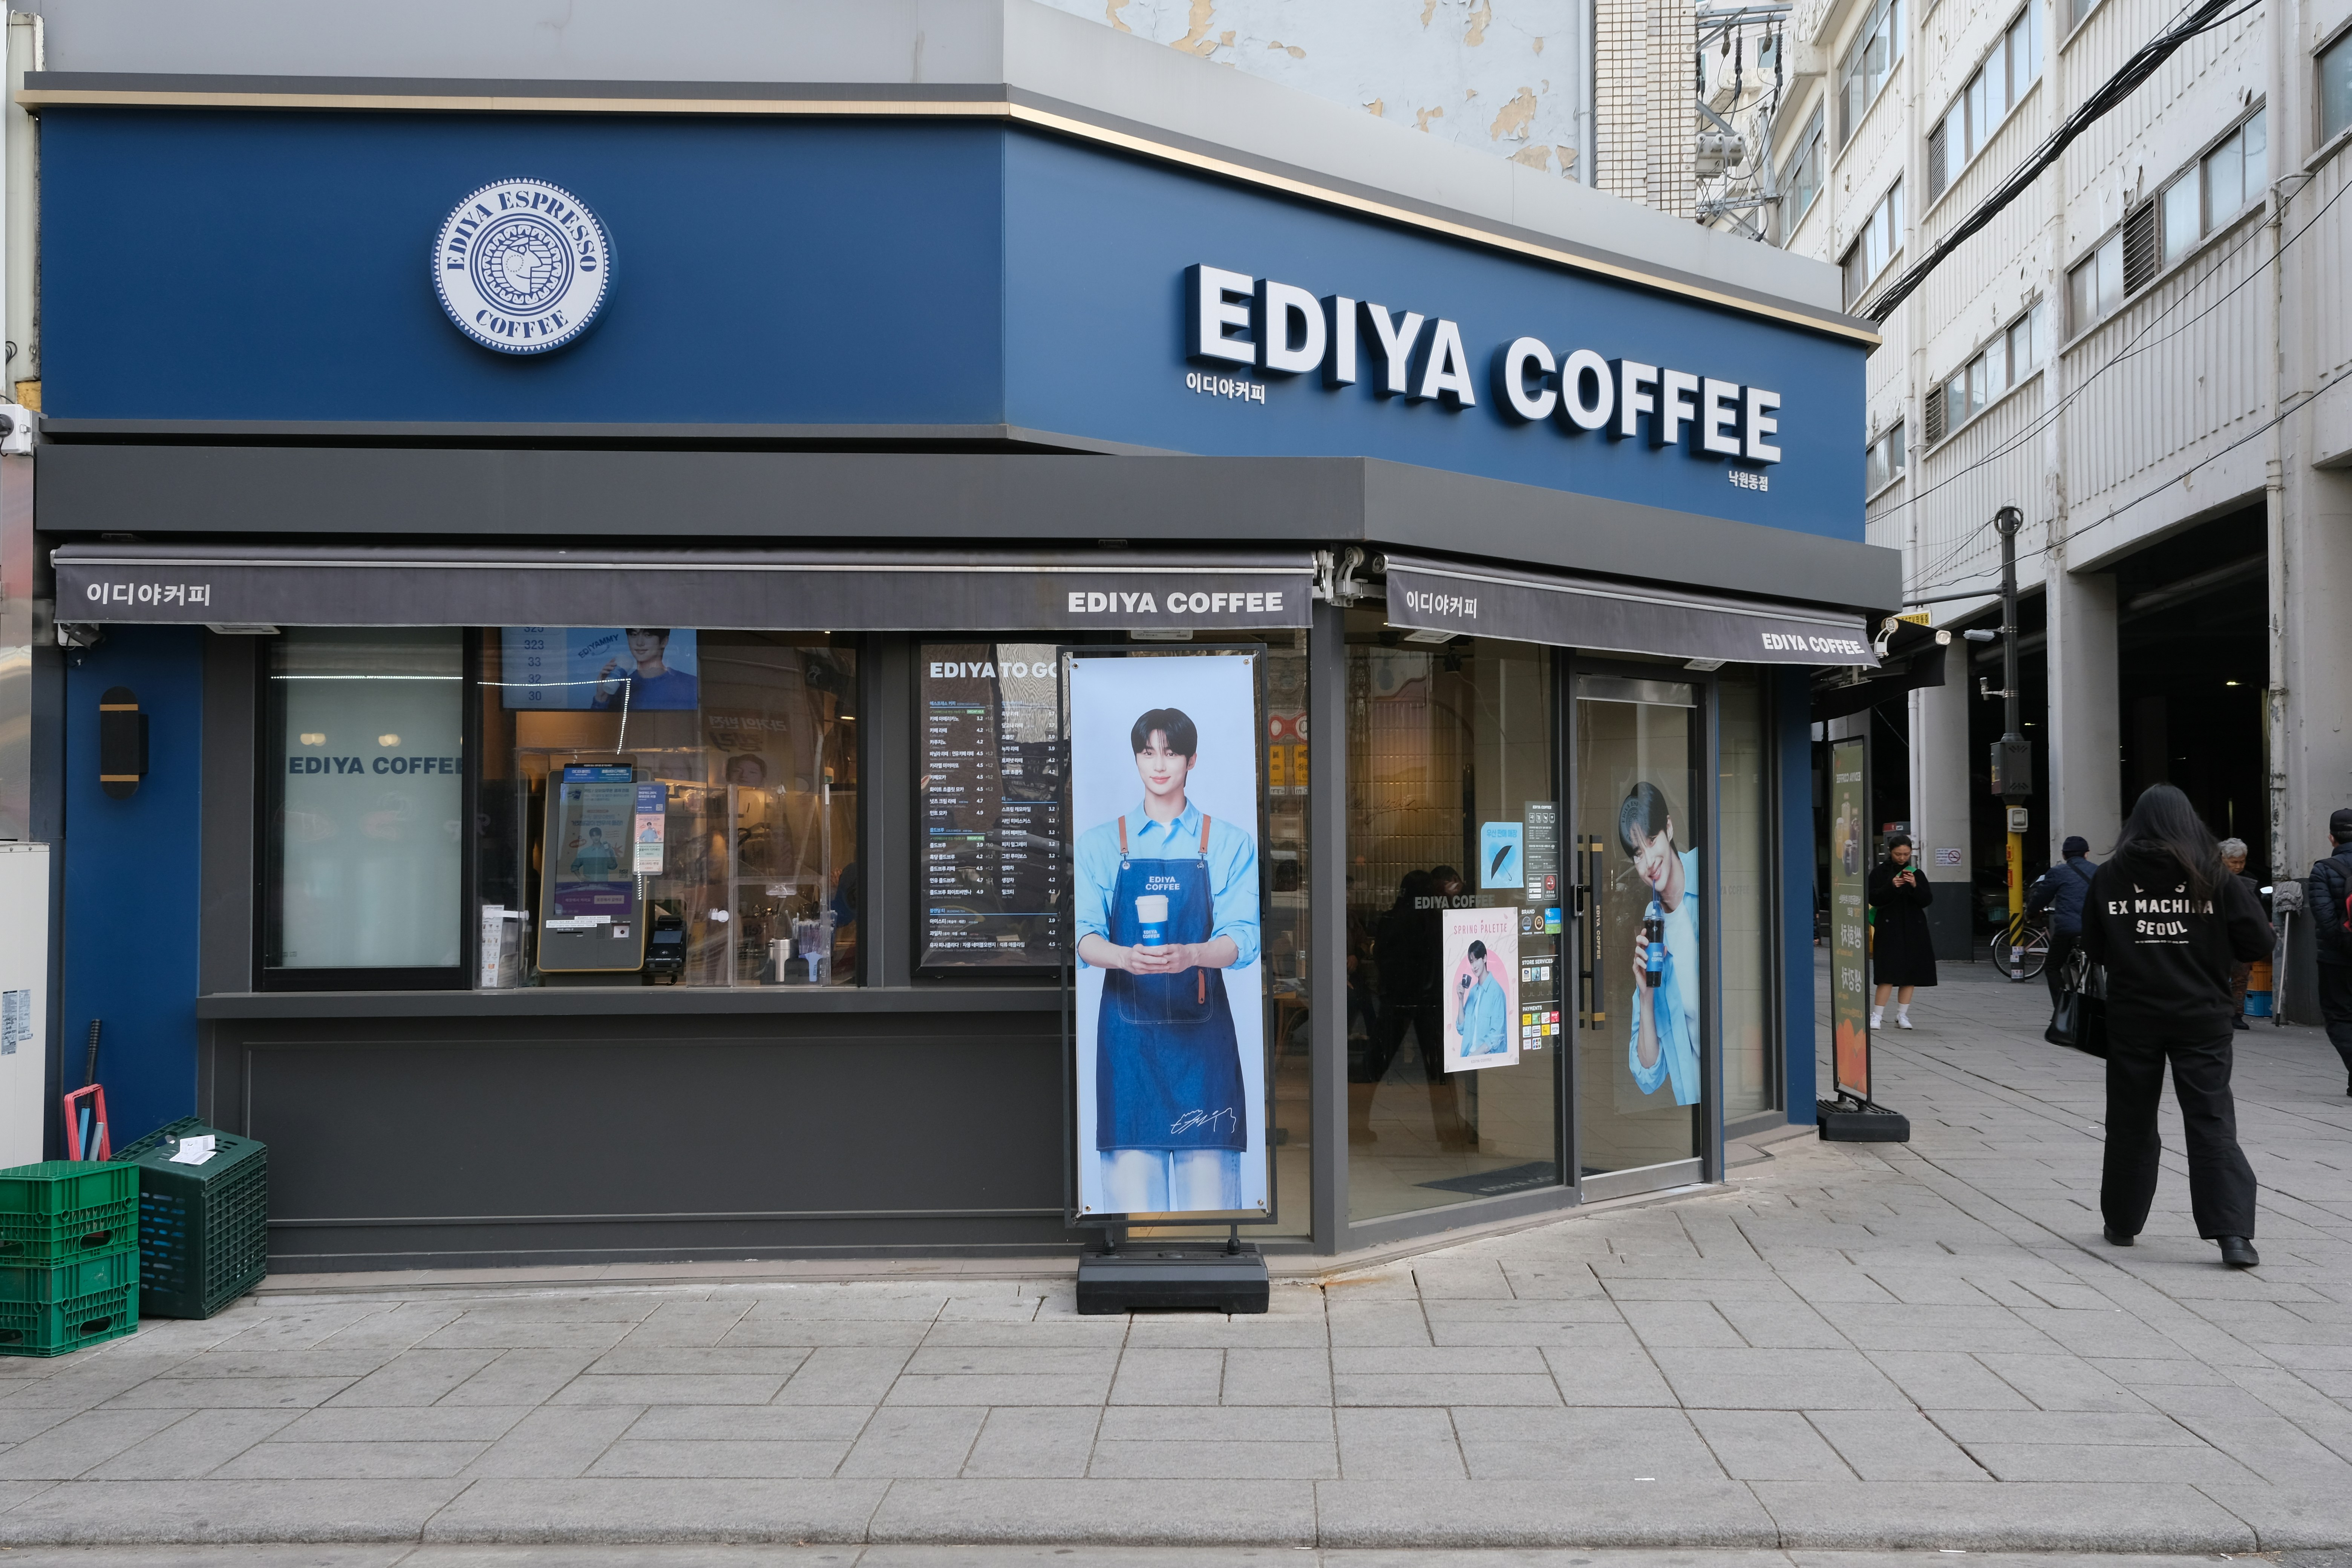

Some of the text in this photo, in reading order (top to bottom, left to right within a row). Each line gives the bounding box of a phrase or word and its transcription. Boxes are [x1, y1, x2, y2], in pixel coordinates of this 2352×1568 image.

[447, 191, 596, 272] EDIYA ESPRESSO
[476, 310, 568, 338] COFFEE
[1199, 263, 1781, 464] EDIYA COFFEE
[1186, 373, 1265, 404] 이디야커피
[1728, 470, 1768, 492] 낙원동점
[87, 583, 210, 606] 이디야커피
[1069, 592, 1283, 613] EDIYA COFFEE
[1406, 591, 1477, 619] 이디야커피
[524, 640, 544, 649] 323
[578, 634, 618, 658] EDIYAMMY
[1761, 633, 1865, 654] EDIYA COFFEE
[528, 657, 541, 666] 33
[930, 662, 996, 678] EDIYA
[1000, 662, 1028, 678] TO
[528, 674, 541, 683] 32
[528, 691, 541, 700] 30
[289, 756, 364, 774] EDIYA
[1497, 829, 1507, 838] 판매
[1415, 894, 1495, 909] EDIYA COFFEE
[2108, 900, 2129, 915] EX
[1454, 923, 1507, 935] SPRING PALETTE
[2136, 920, 2188, 936] SEOUL
